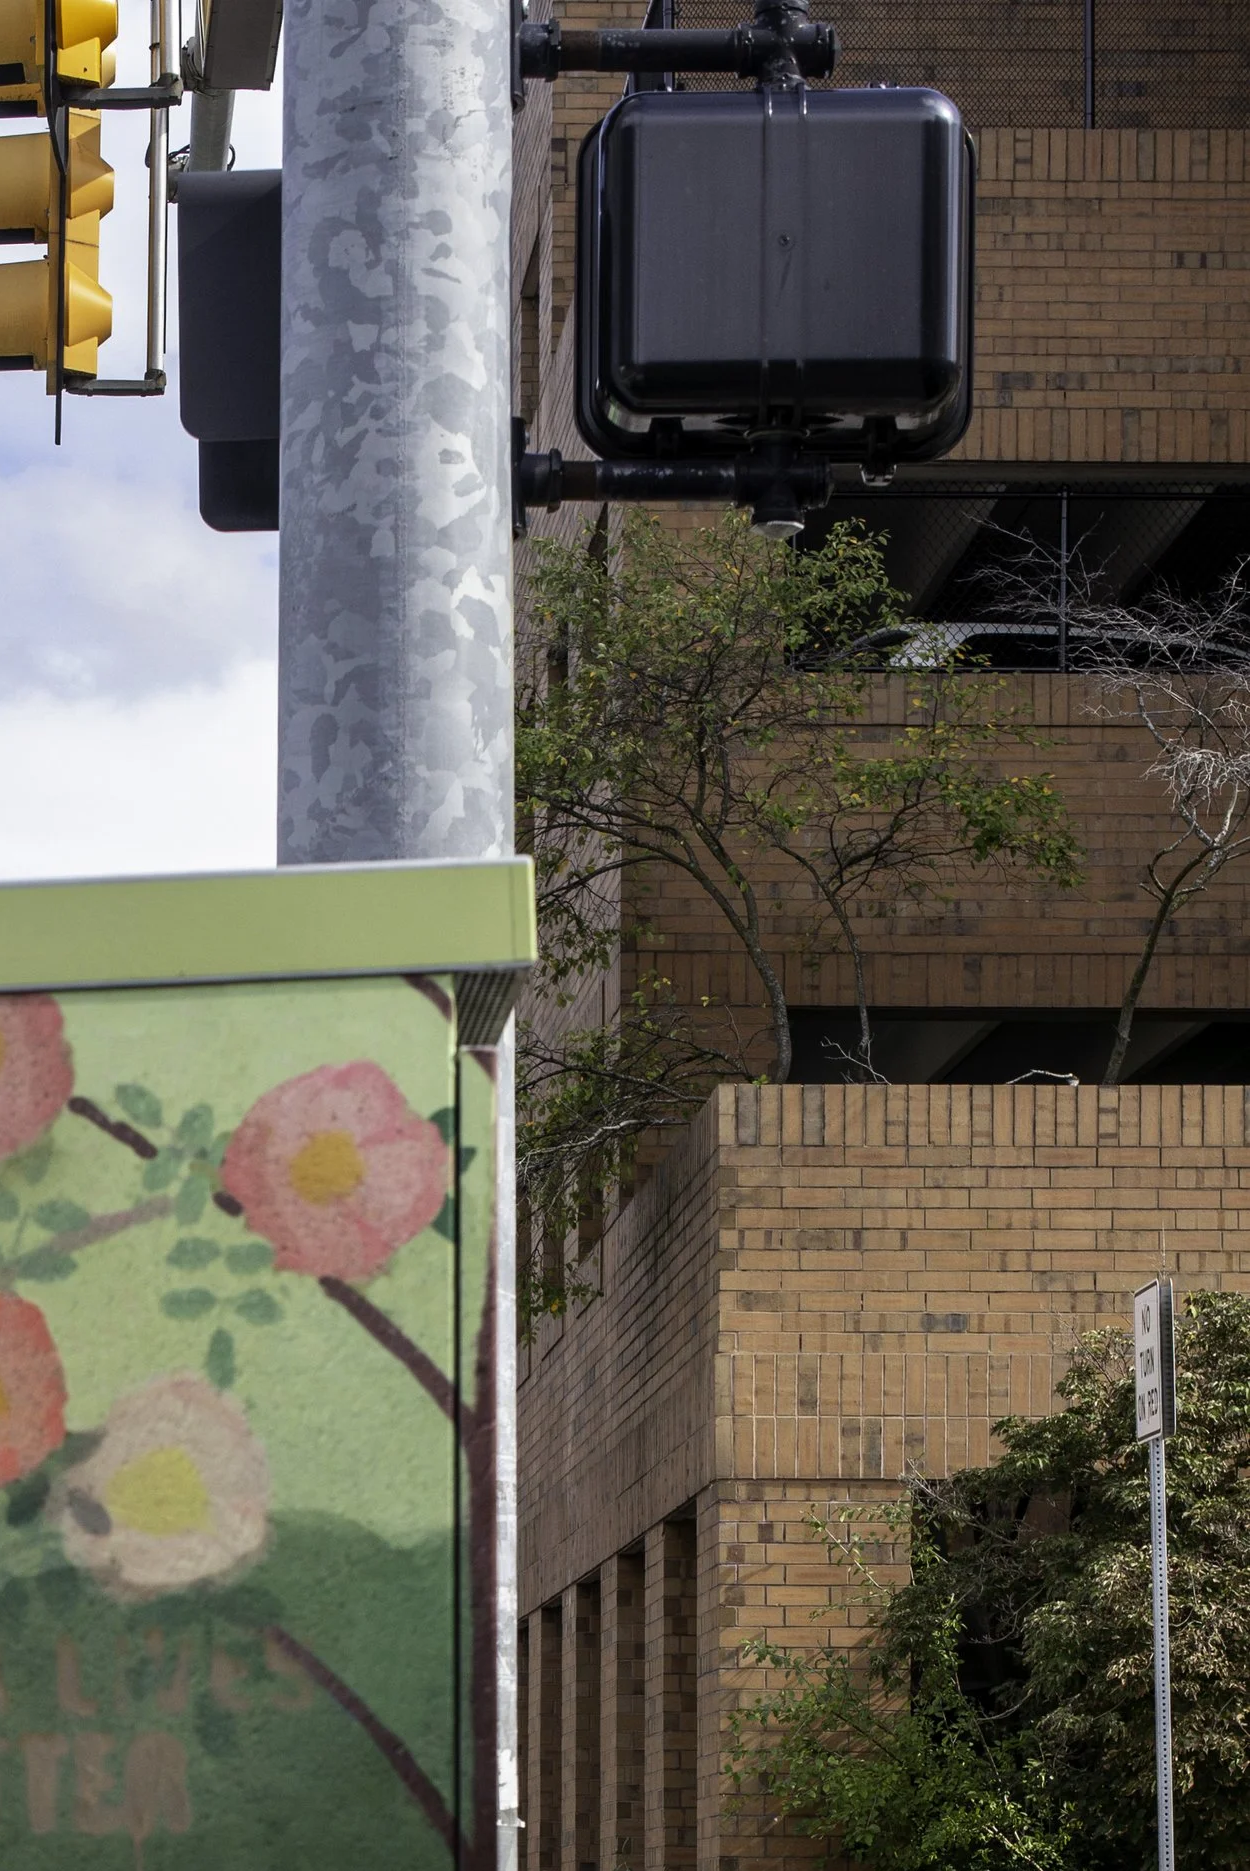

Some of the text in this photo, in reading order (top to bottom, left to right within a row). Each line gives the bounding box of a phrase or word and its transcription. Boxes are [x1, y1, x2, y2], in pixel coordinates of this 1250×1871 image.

[1141, 1303, 1151, 1336] NO
[1139, 1345, 1155, 1379] TURN
[1137, 1387, 1159, 1424] ON RED
